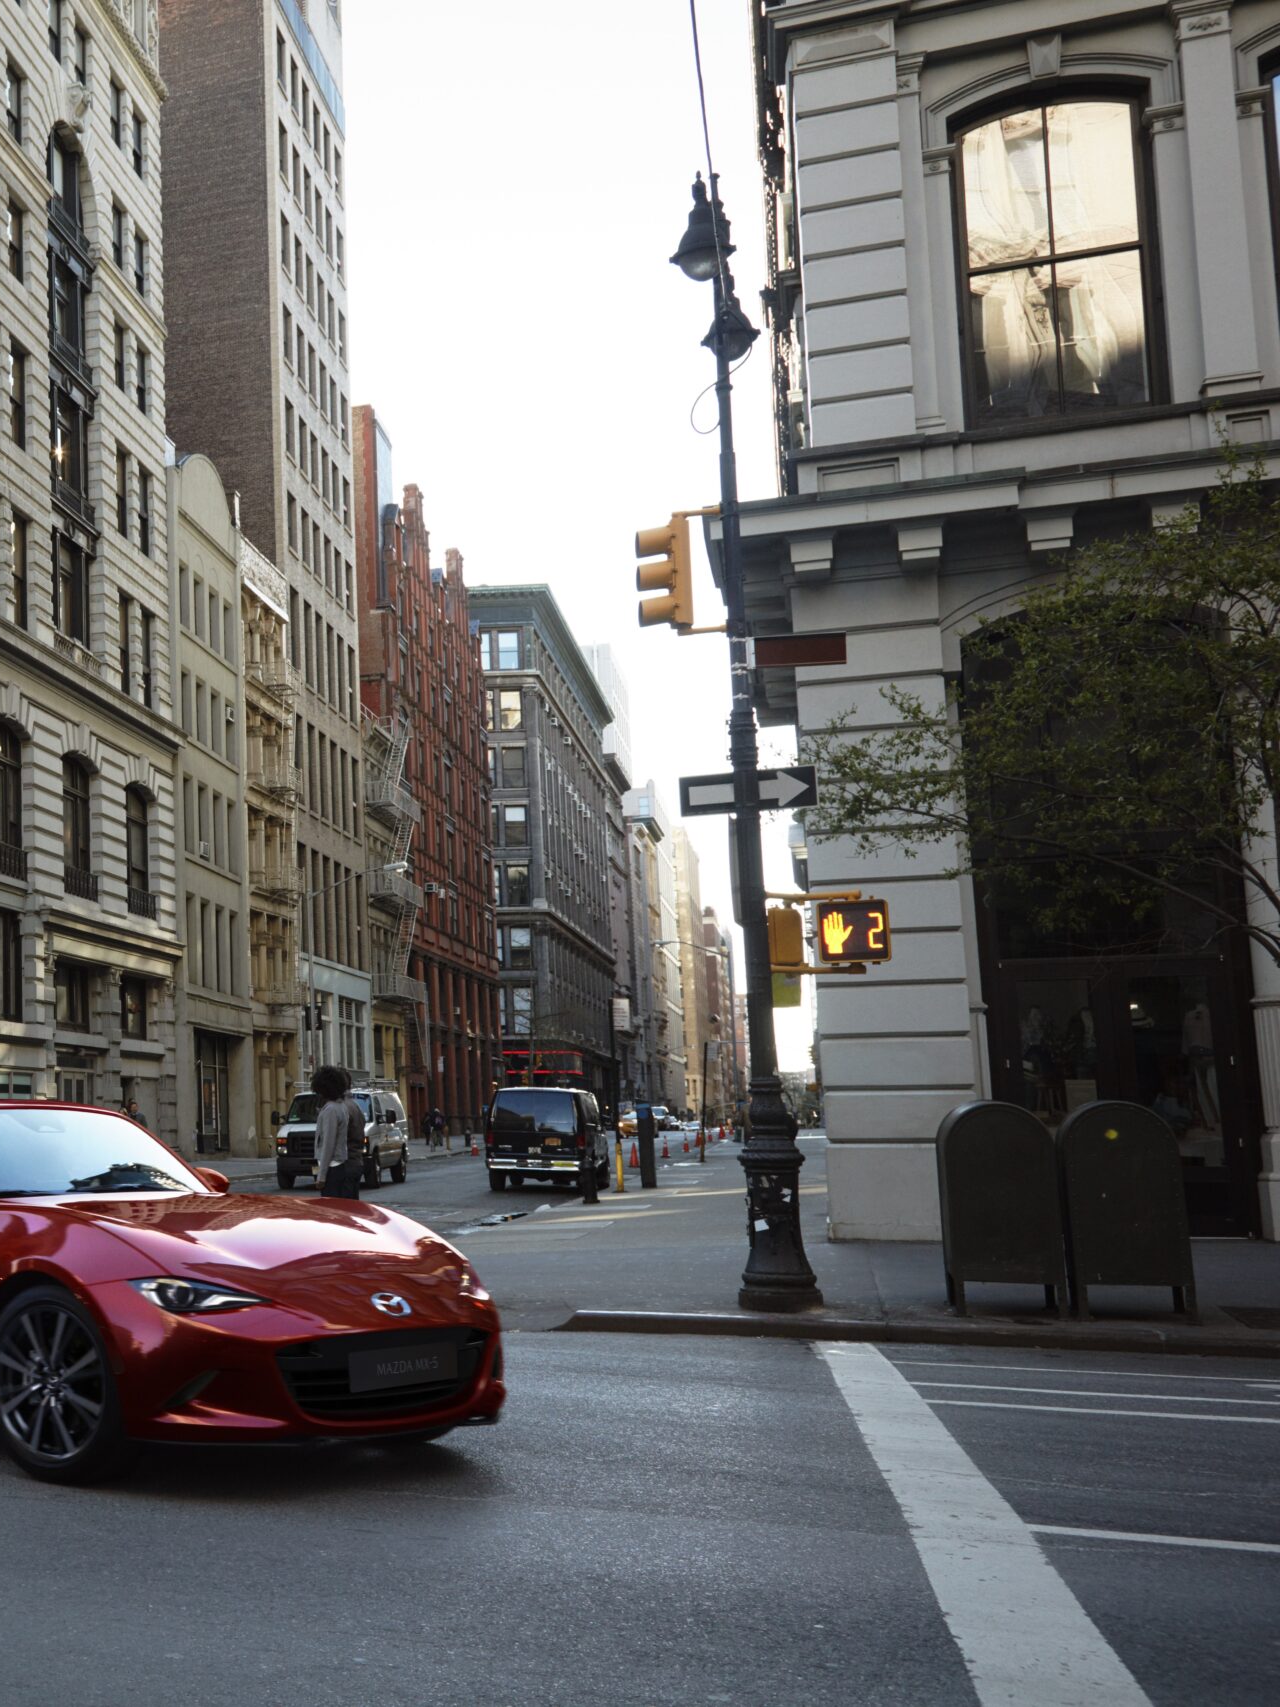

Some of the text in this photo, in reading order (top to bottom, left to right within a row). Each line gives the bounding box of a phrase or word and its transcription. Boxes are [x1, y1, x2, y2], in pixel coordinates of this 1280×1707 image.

[867, 911, 884, 949] 2
[376, 1355, 440, 1376] MAZDA MX-5
